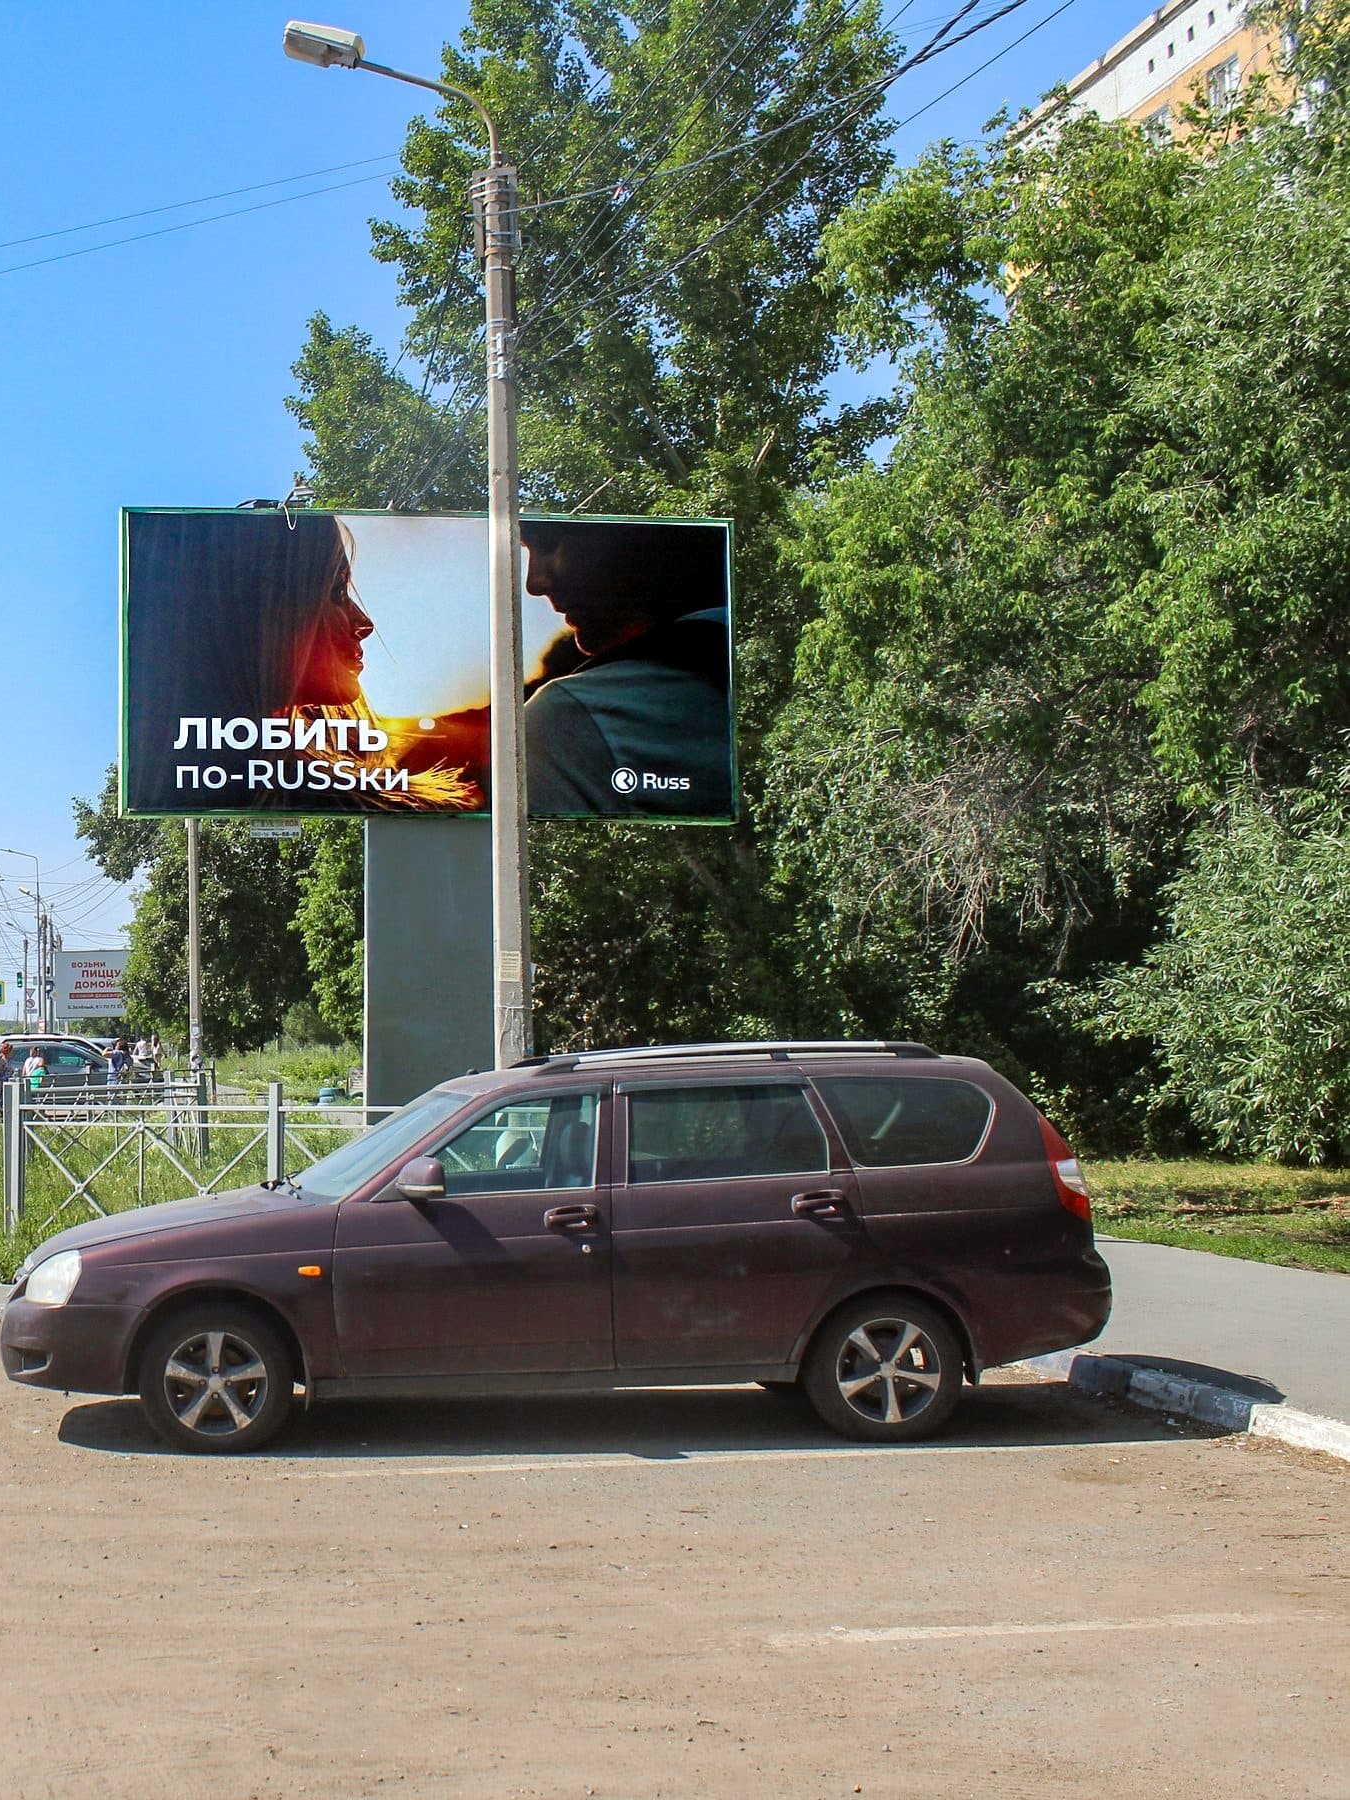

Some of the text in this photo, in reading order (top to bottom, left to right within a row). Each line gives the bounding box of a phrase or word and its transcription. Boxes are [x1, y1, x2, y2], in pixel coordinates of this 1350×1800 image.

[173, 716, 389, 752] ЛЮБИТЬ
[176, 759, 409, 792] по-RUSSки
[642, 772, 691, 790] Russ
[71, 961, 106, 969] ВОЗЬМИ
[81, 969, 121, 979] ПИЦЦУ
